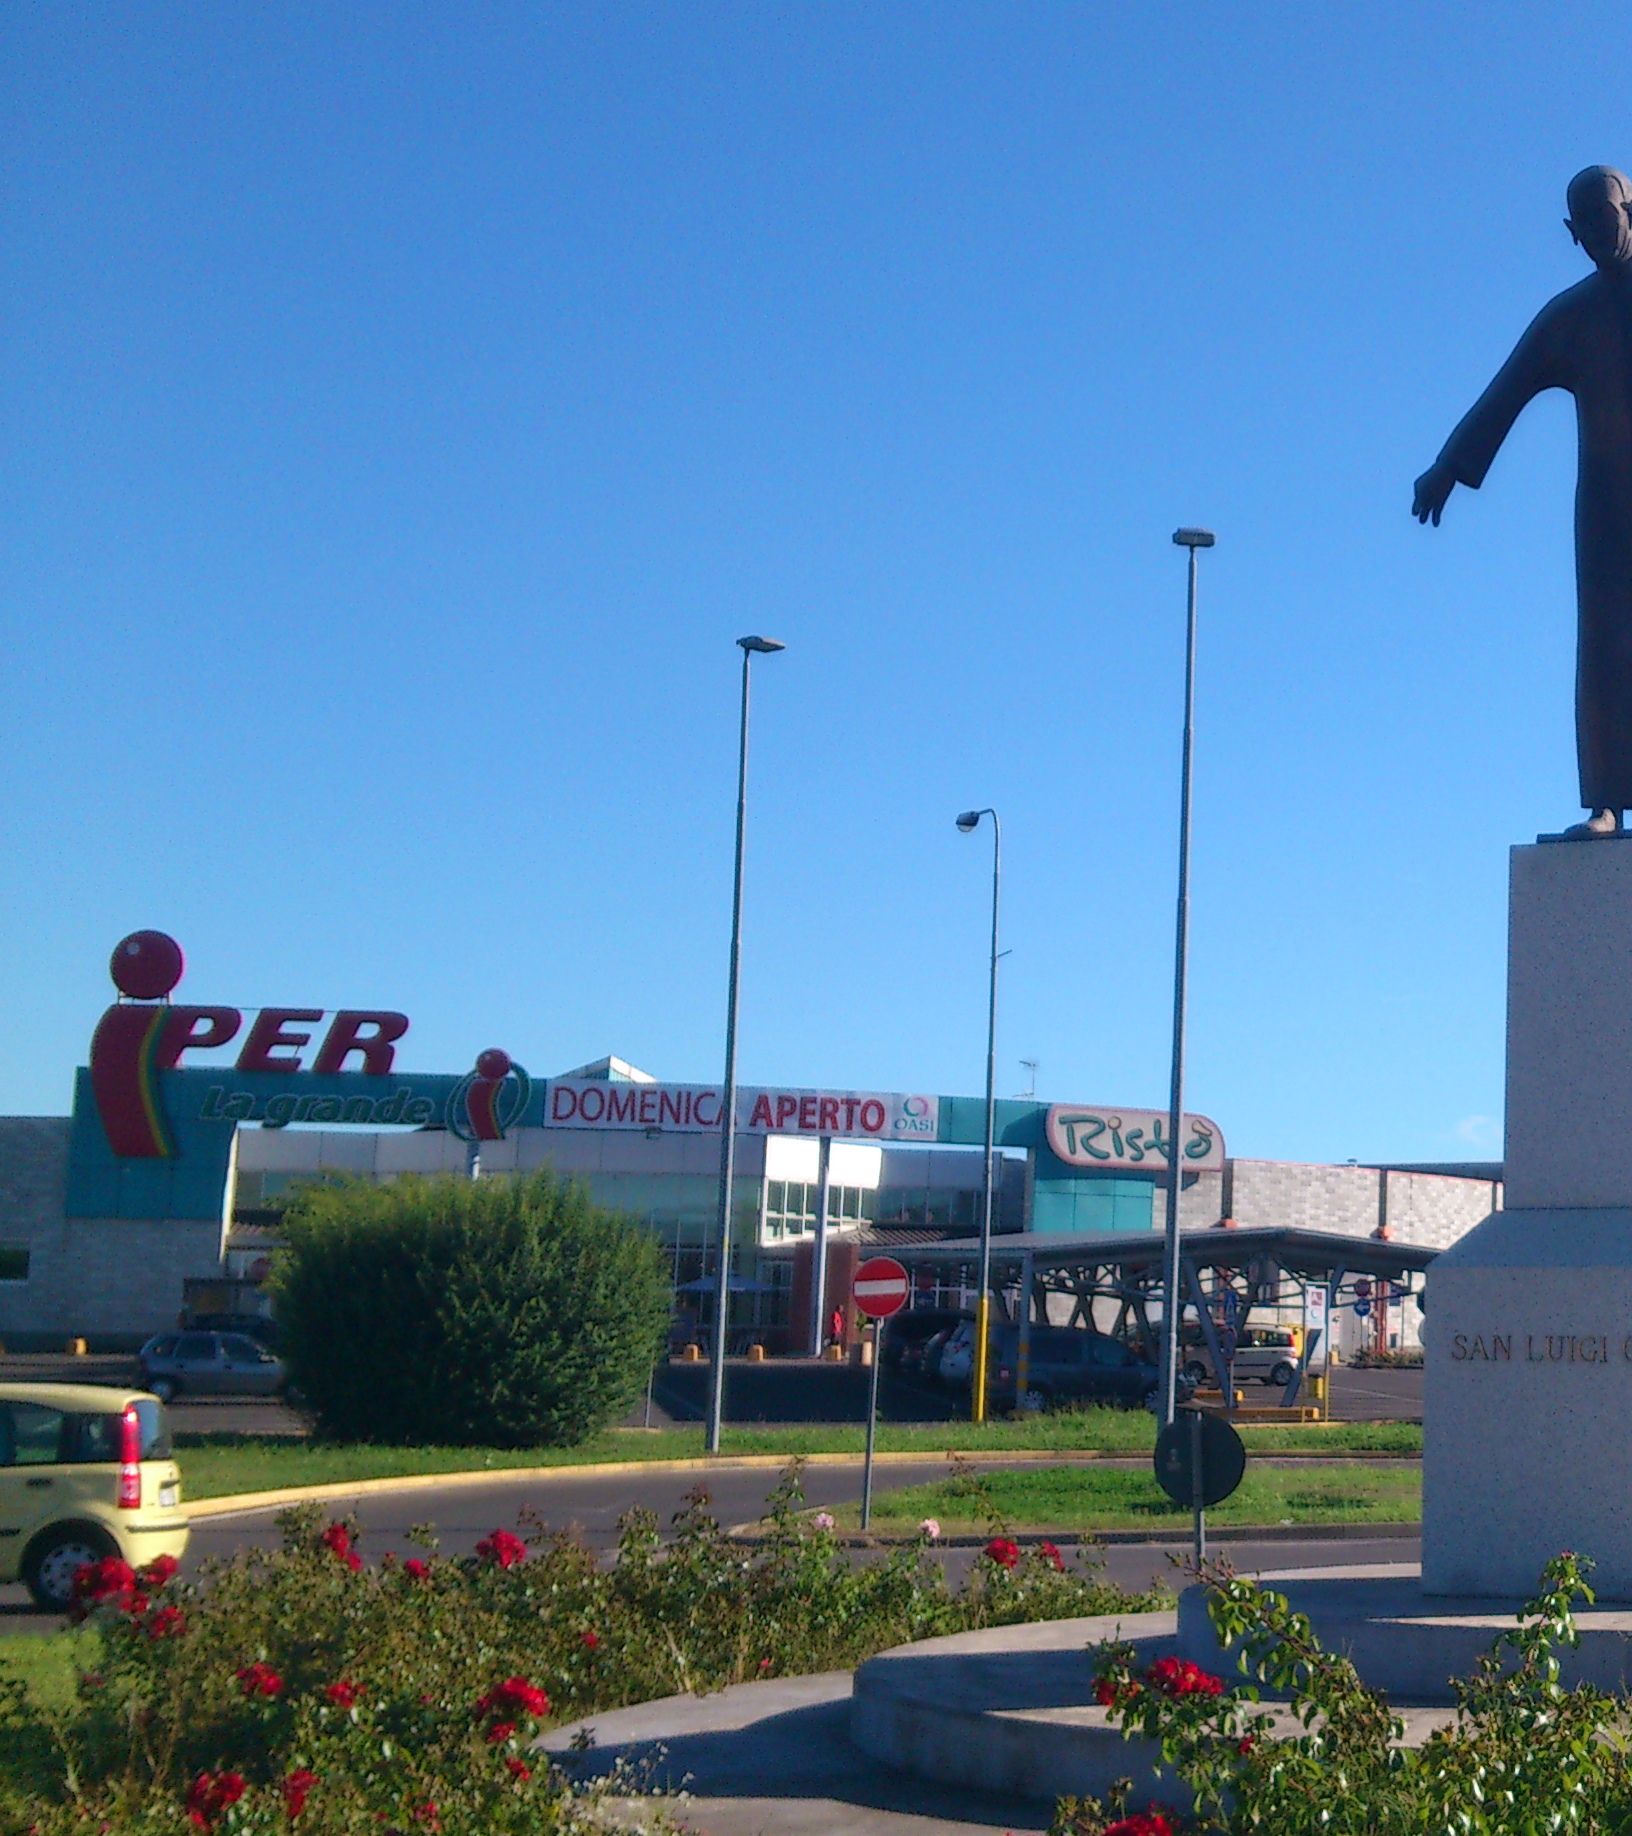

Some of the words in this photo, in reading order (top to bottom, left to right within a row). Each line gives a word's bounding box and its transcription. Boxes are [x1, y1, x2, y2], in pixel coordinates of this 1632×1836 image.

[203, 1086, 255, 1120] La
[262, 1088, 434, 1128] grande
[749, 1094, 886, 1132] APERTO
[893, 1117, 935, 1133] OASI
[1451, 1334, 1512, 1362] SAN
[1525, 1335, 1607, 1363] LUIGI
